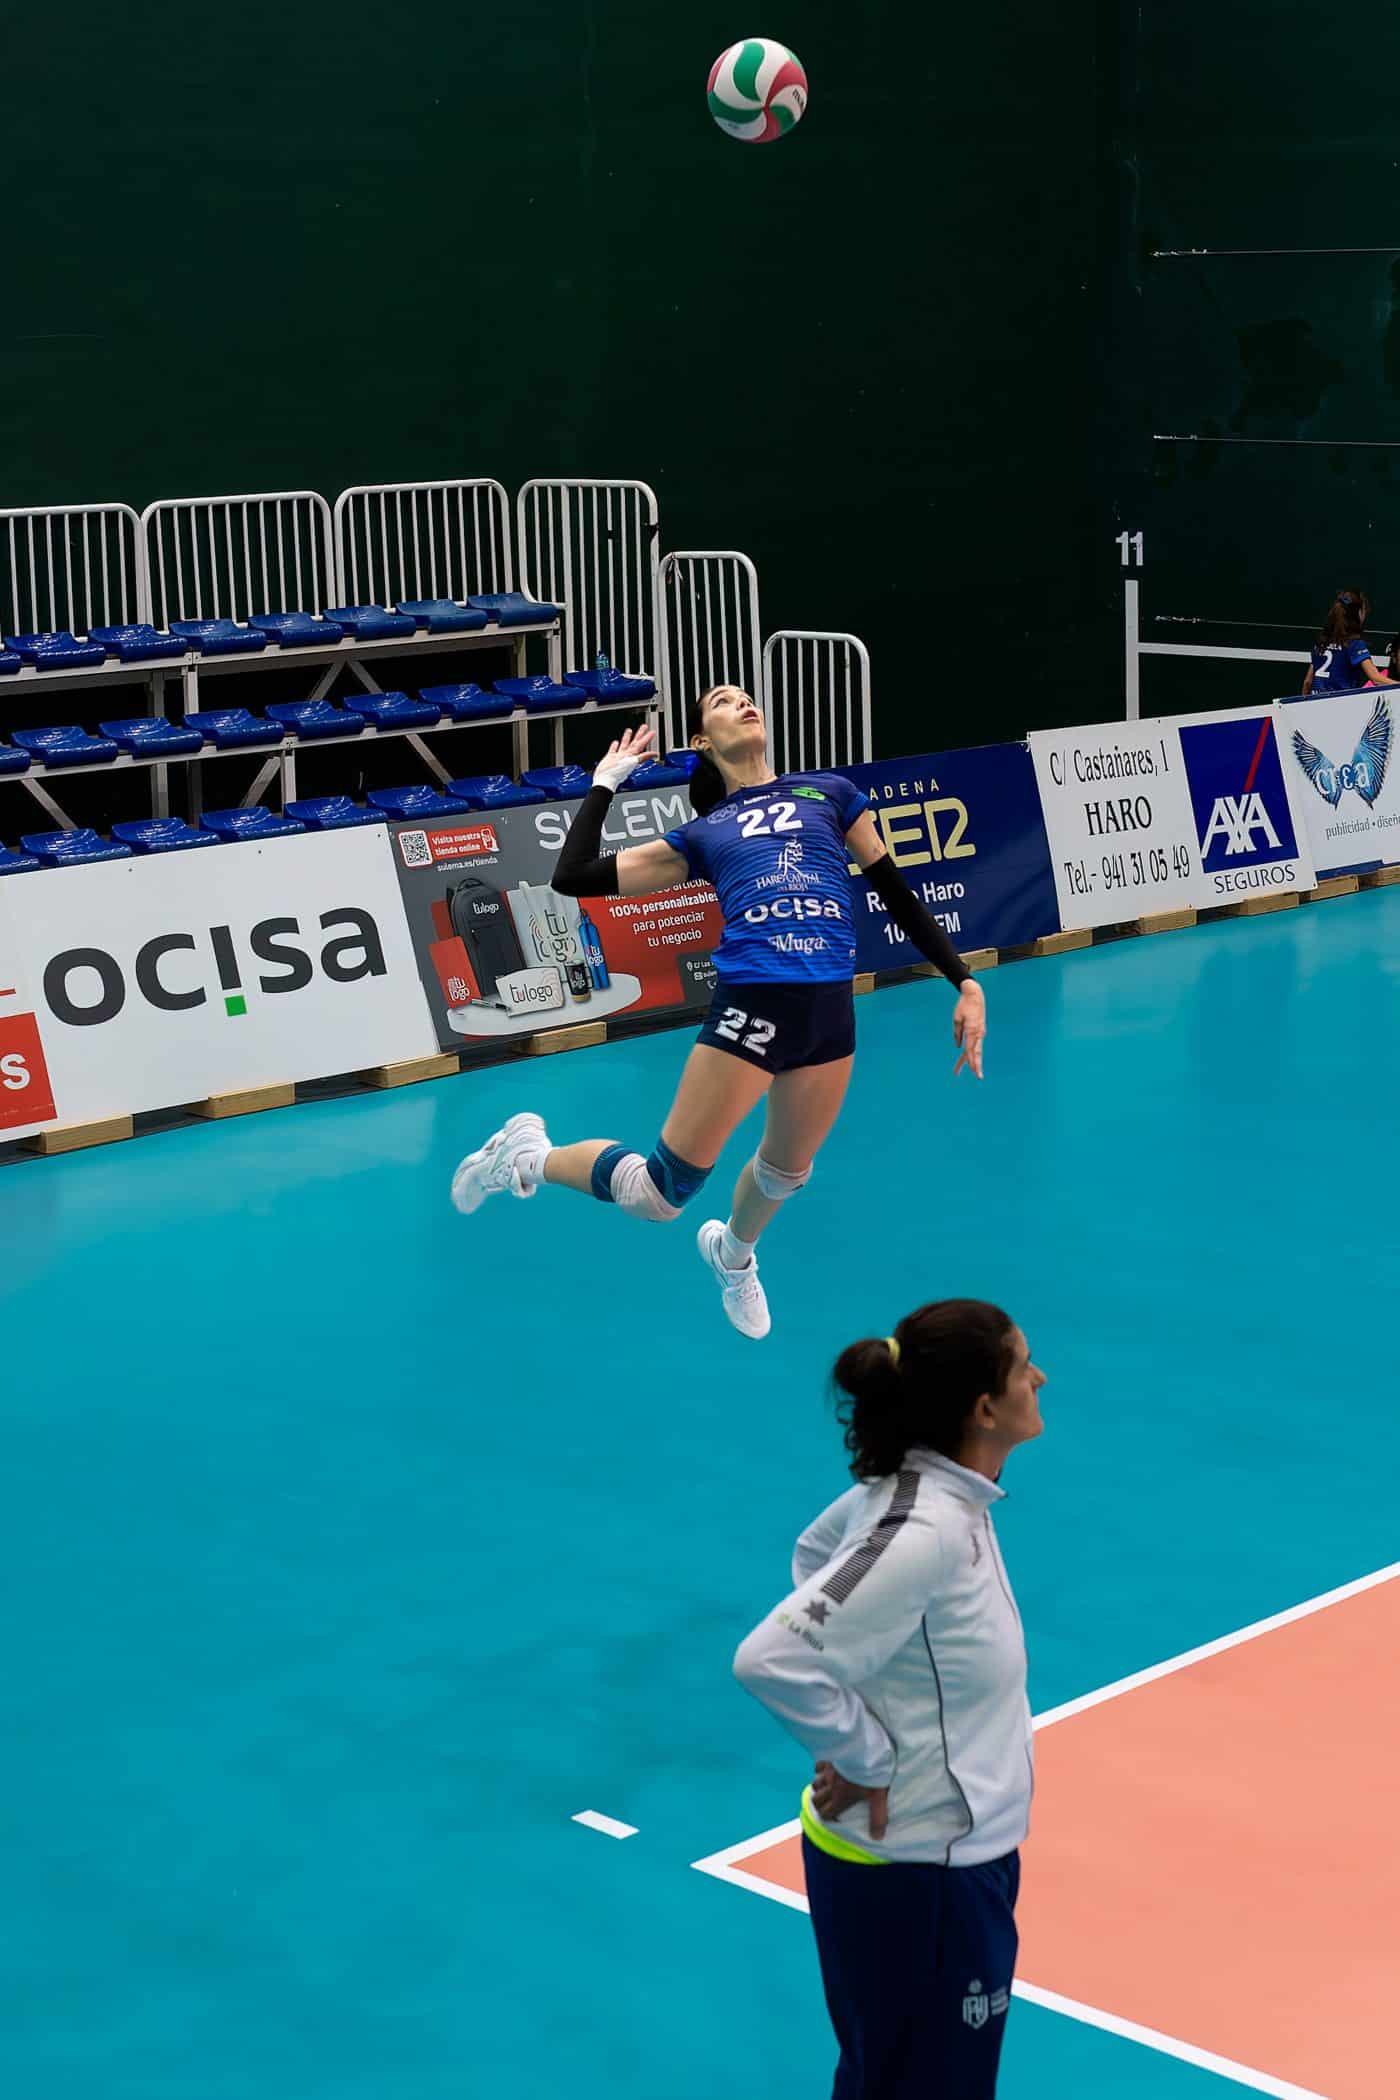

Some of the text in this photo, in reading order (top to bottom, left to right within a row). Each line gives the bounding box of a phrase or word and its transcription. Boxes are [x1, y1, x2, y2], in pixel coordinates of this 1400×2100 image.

[1115, 531, 1143, 566] 11
[1315, 650, 1332, 678] 2
[1049, 752, 1066, 786] C/
[869, 778, 940, 801] ADENA
[535, 794, 699, 850] SLEM
[736, 801, 803, 838] 22
[1083, 796, 1152, 836] HARO
[1200, 792, 1283, 859] AXA
[1326, 817, 1369, 840] publicidad
[432, 832, 480, 845] Visita nuestra
[435, 843, 480, 856] tienda online
[1102, 854, 1127, 890] 941
[1130, 851, 1147, 885] 31
[1149, 849, 1168, 882] 05
[1173, 845, 1190, 878] 49
[1214, 864, 1295, 894] SEGUROS
[922, 881, 965, 903] Haro
[544, 909, 568, 936] tu
[608, 903, 641, 919] 100%
[633, 911, 705, 935] para potenciar
[744, 897, 841, 923] ocisa
[648, 928, 702, 947] tu negocio
[770, 932, 829, 956] Muga
[43, 905, 388, 1027] ocisa
[715, 1006, 776, 1056] 22
